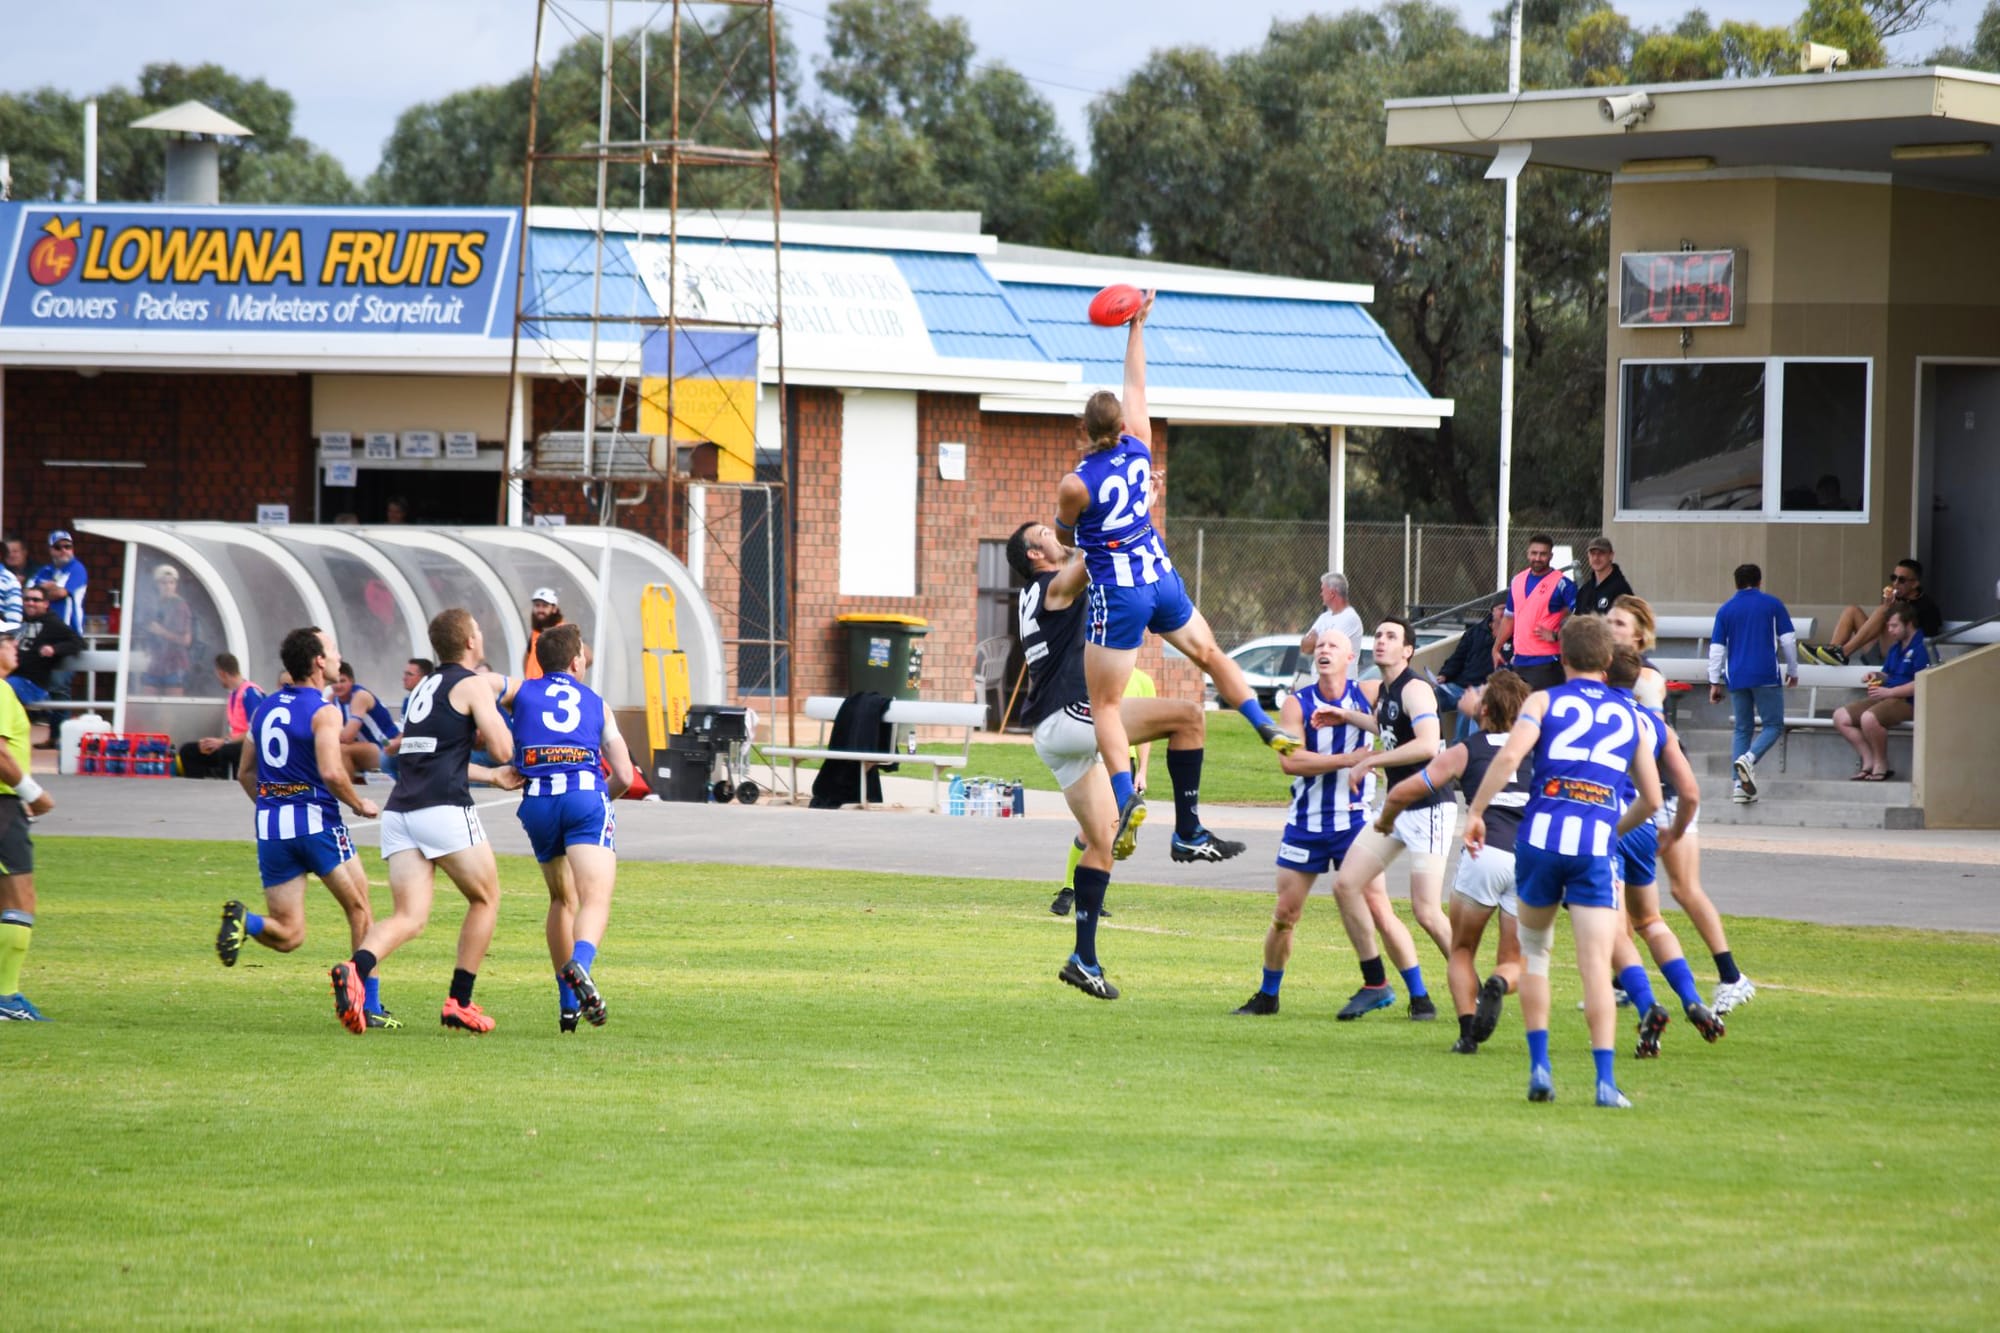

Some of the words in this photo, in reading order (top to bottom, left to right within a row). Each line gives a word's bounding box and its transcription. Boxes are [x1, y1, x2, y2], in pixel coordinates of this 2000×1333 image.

[81, 224, 304, 286] LOWANA
[320, 229, 488, 287] FRUITS
[32, 290, 117, 320] Growers
[134, 291, 209, 321] Packers
[227, 293, 328, 323] Marketers
[333, 295, 361, 322] of
[362, 295, 464, 326] Stonefruit
[1098, 458, 1150, 531] 23
[261, 706, 291, 768] 6
[542, 683, 581, 733] 3
[1548, 695, 1634, 773] 22
